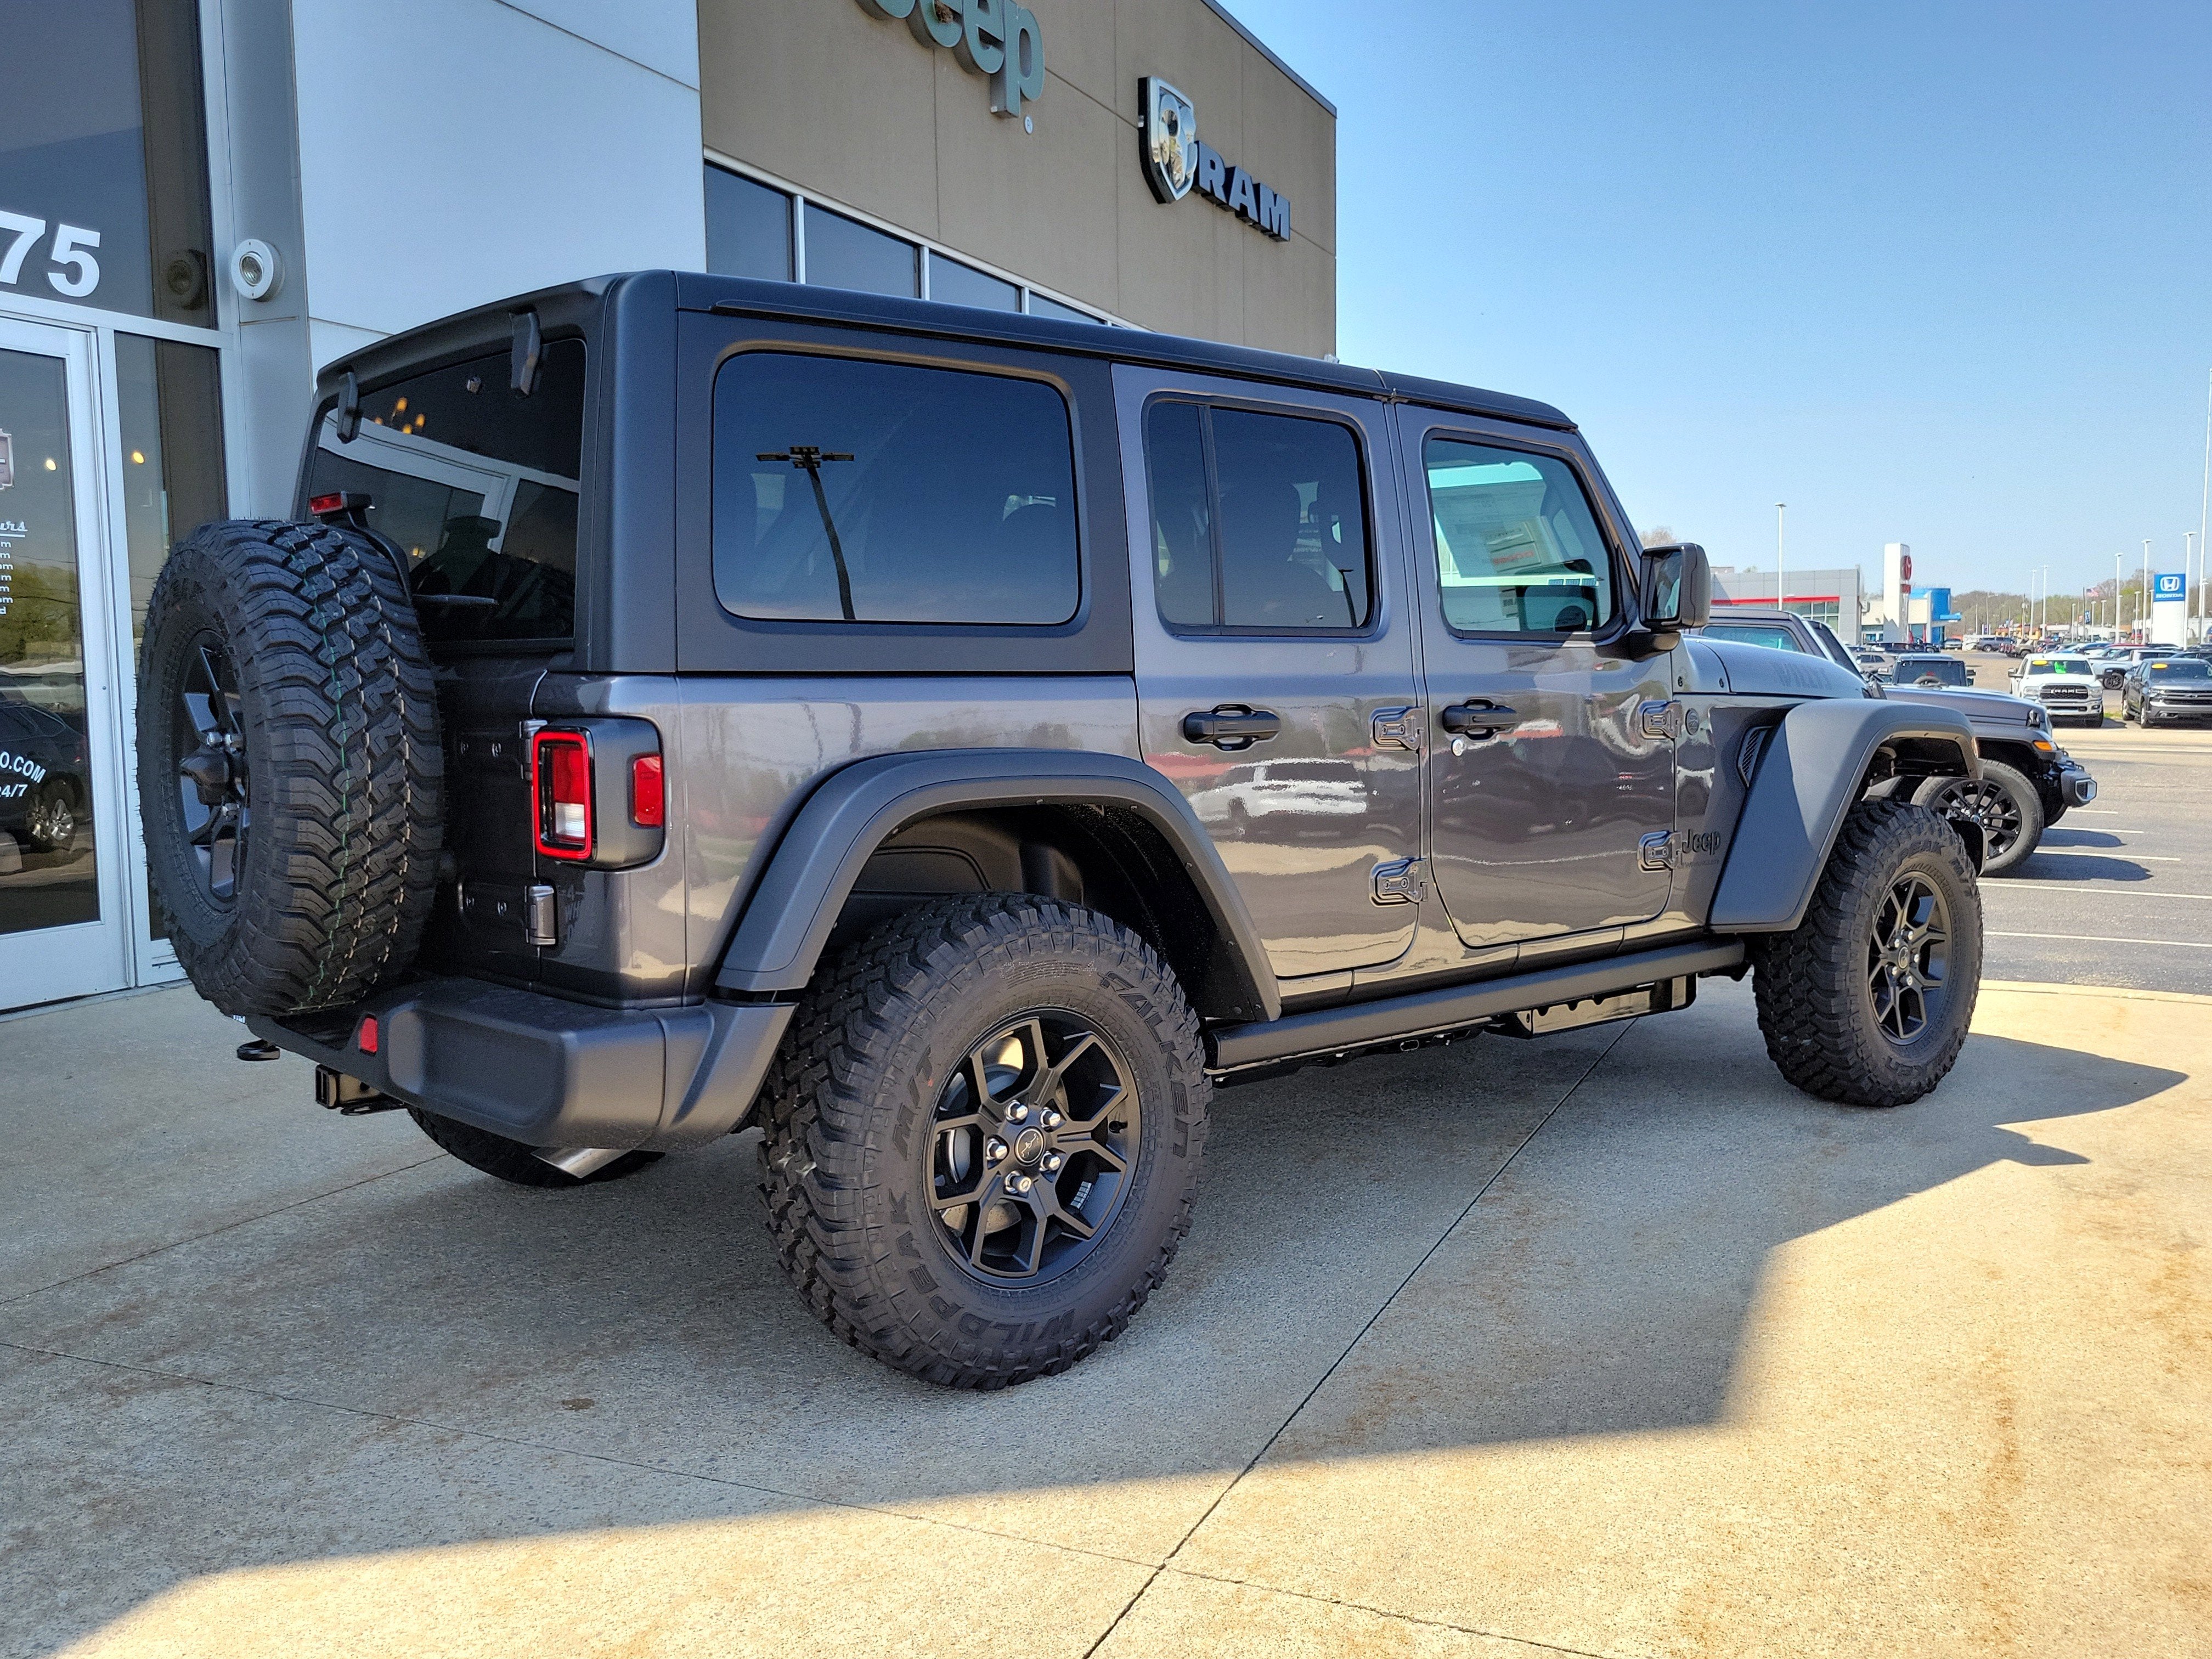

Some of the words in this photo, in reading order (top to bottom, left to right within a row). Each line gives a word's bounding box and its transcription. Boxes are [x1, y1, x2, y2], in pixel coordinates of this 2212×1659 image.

[1196, 140, 1290, 241] RAM
[0, 210, 101, 297] 75
[0, 752, 46, 783] O.COM
[0, 784, 28, 797] 4/7
[1682, 829, 1720, 855] Jeep
[1097, 971, 1189, 1158] FALKEN
[889, 1188, 1075, 1343] WILDPEAK
